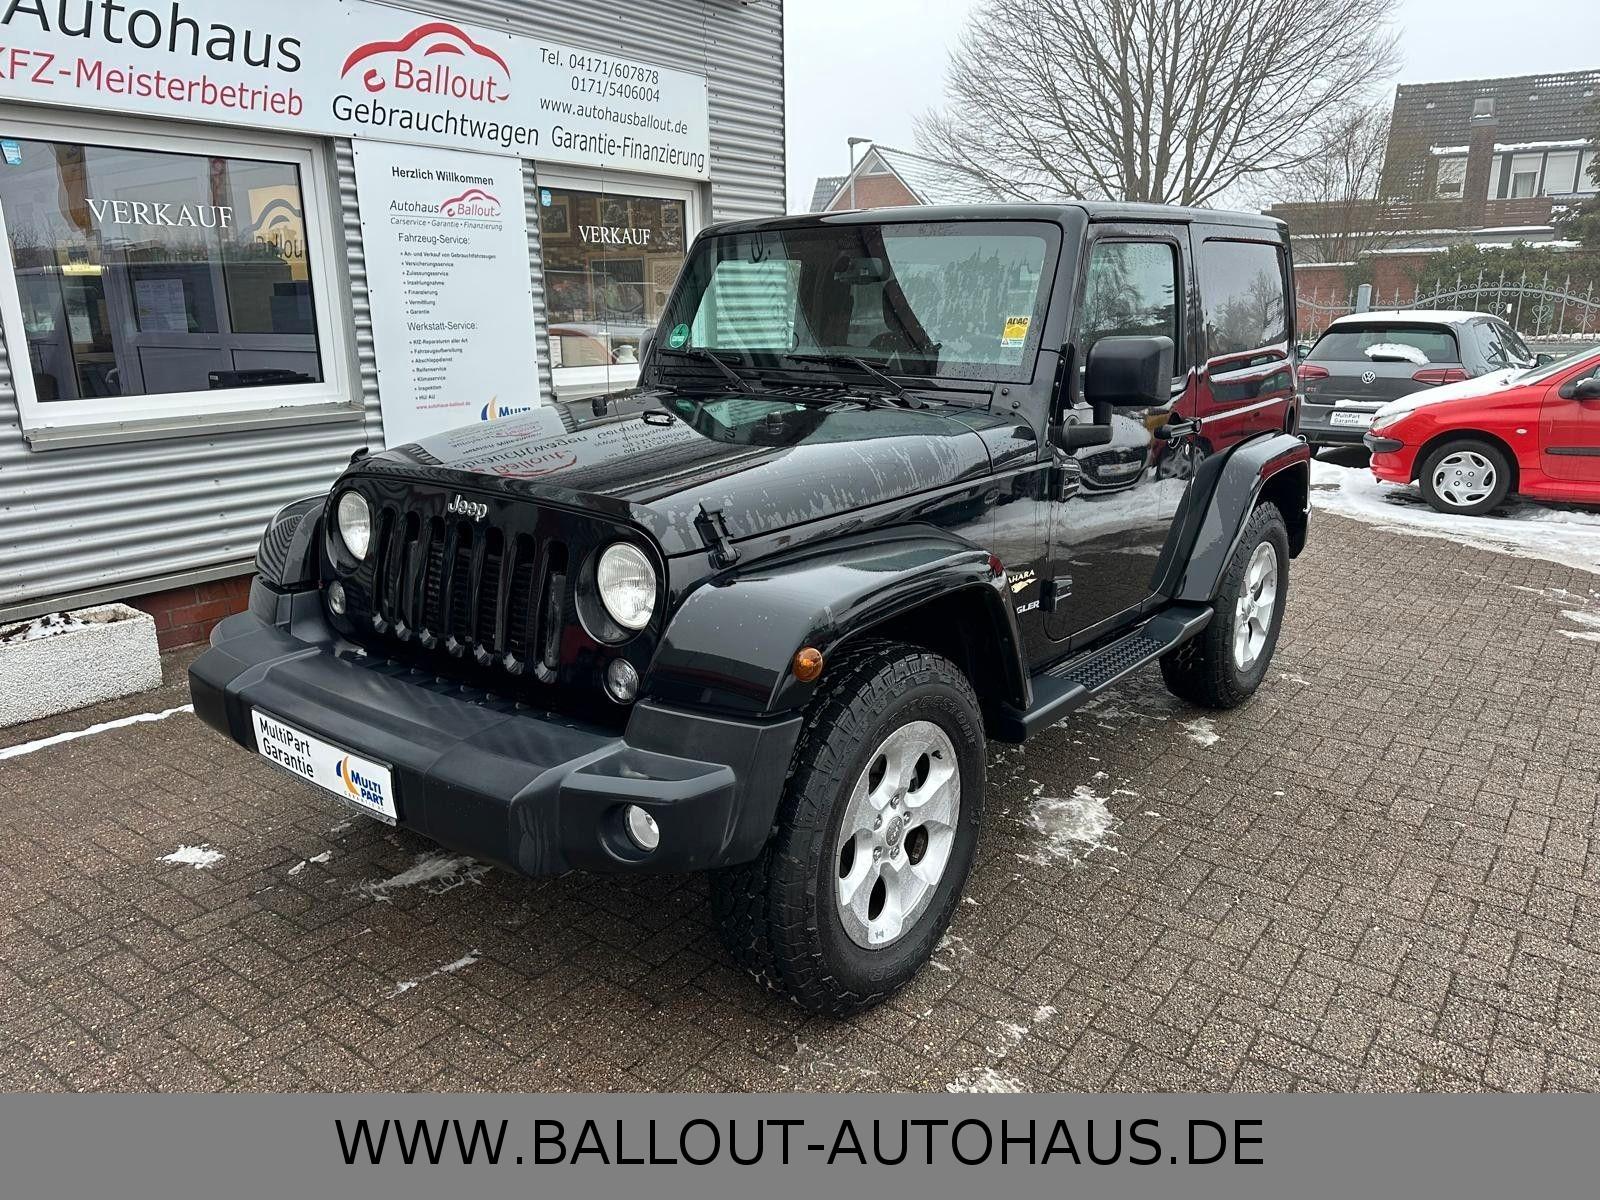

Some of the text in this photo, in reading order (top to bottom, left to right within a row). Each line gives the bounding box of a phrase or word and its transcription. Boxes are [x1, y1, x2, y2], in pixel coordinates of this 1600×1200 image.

[1, 0, 301, 72] Autohaus
[540, 48, 659, 85] Tel. 04171/607878
[0, 46, 303, 116] FZ-Meisterbetrieb
[395, 58, 497, 103] Ballout
[571, 76, 660, 103] 0171/5406004
[332, 95, 539, 147] Gebrauchtwagen
[540, 97, 688, 135] www.autohausballout.de
[552, 125, 704, 173] Garantie-Finanzierung
[392, 166, 494, 186] Herzlich Willkommen
[85, 198, 233, 229] VERKAUF
[390, 200, 439, 213] Autohaus
[457, 203, 495, 217] Ballout
[390, 217, 503, 231] Carservice Garantie Finanzierung
[578, 225, 651, 245] VERKAUF
[398, 232, 470, 245] Fahrzeug-Service:
[407, 321, 478, 331] Werkstatt-Service:
[1007, 317, 1029, 325] ADAC
[447, 494, 488, 522] Jeep
[259, 717, 311, 757] MultiPart
[262, 737, 314, 778] Garantie
[351, 769, 382, 795] MULTI
[361, 788, 384, 806] PART
